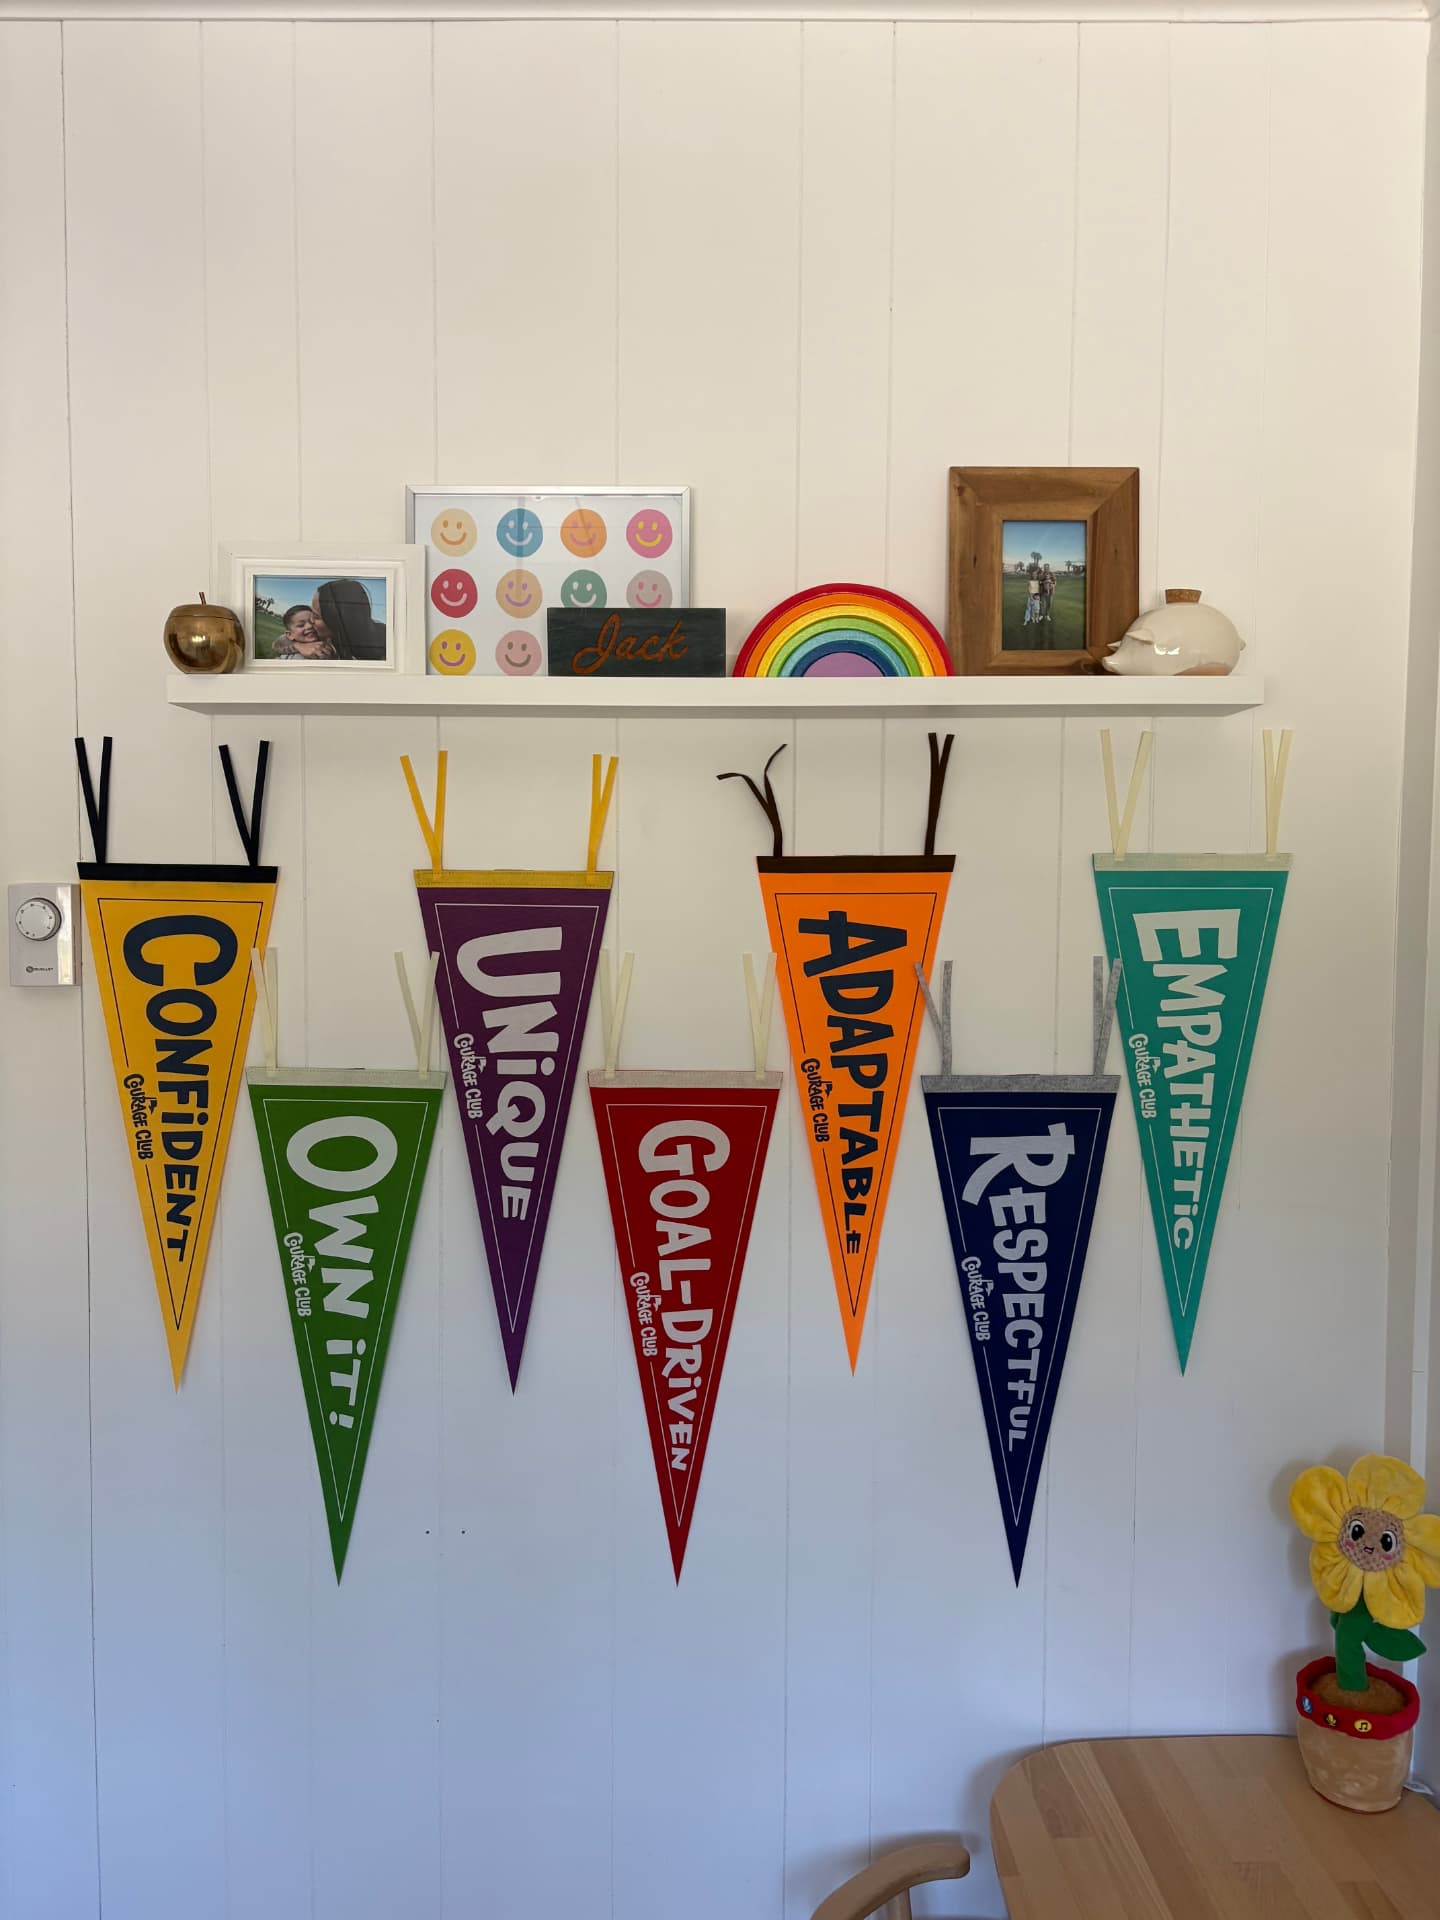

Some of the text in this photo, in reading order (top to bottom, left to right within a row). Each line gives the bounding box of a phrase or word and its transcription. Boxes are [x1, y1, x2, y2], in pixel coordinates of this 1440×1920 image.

[571, 612, 689, 675] Jack
[798, 910, 908, 1254] ADAPTABLE
[464, 1089, 484, 1119] CLUB
[1138, 1089, 1157, 1119] CLUB
[812, 1113, 830, 1143] CLUB
[135, 1130, 154, 1161] CLUB
[286, 1115, 399, 1320] OWN
[294, 1287, 313, 1317] CLUB
[962, 1122, 1076, 1452] RESPECTFUL
[972, 1311, 991, 1341] CLUB
[639, 1327, 658, 1357] CLUB
